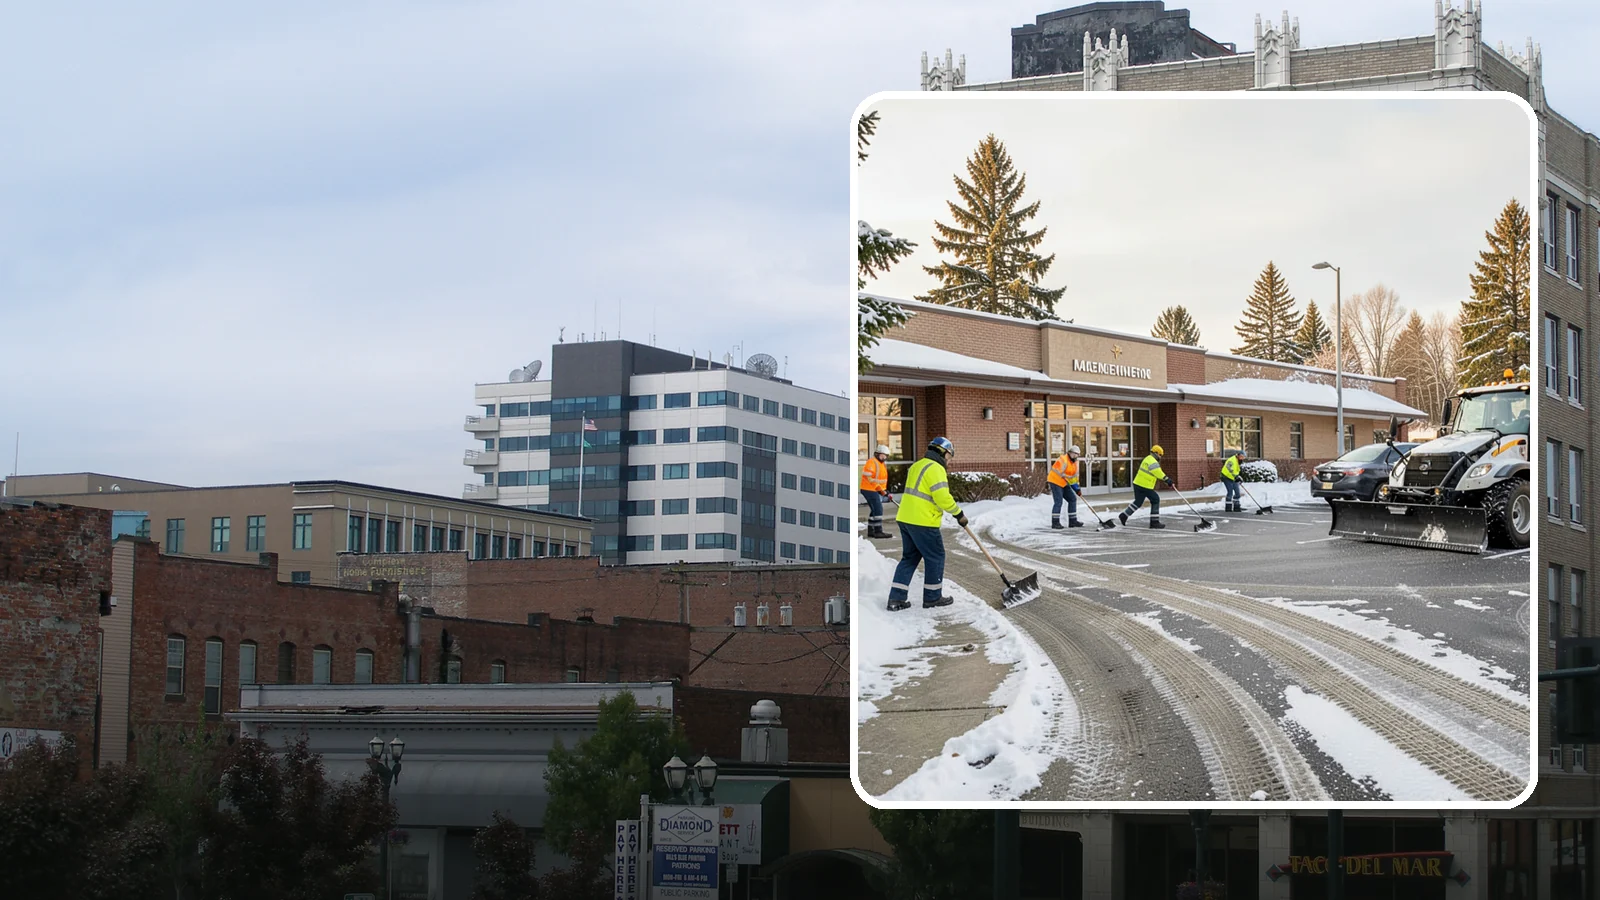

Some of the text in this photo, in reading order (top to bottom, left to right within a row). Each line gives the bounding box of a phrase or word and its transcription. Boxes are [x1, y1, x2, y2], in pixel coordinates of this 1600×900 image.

[371, 567, 427, 576] Furnishers
[660, 818, 713, 832] DIAMOND
[1022, 815, 1070, 828] BUILDING
[656, 845, 716, 854] RESERVED PARKING
[616, 825, 625, 893] PAY HERE
[627, 824, 637, 893] PAY HERE
[722, 851, 739, 862] Soup
[671, 862, 701, 870] PATRONS
[1346, 856, 1384, 876] DEL
[1392, 857, 1443, 877] MAR
[660, 888, 710, 898] PUBLIC PARKING
